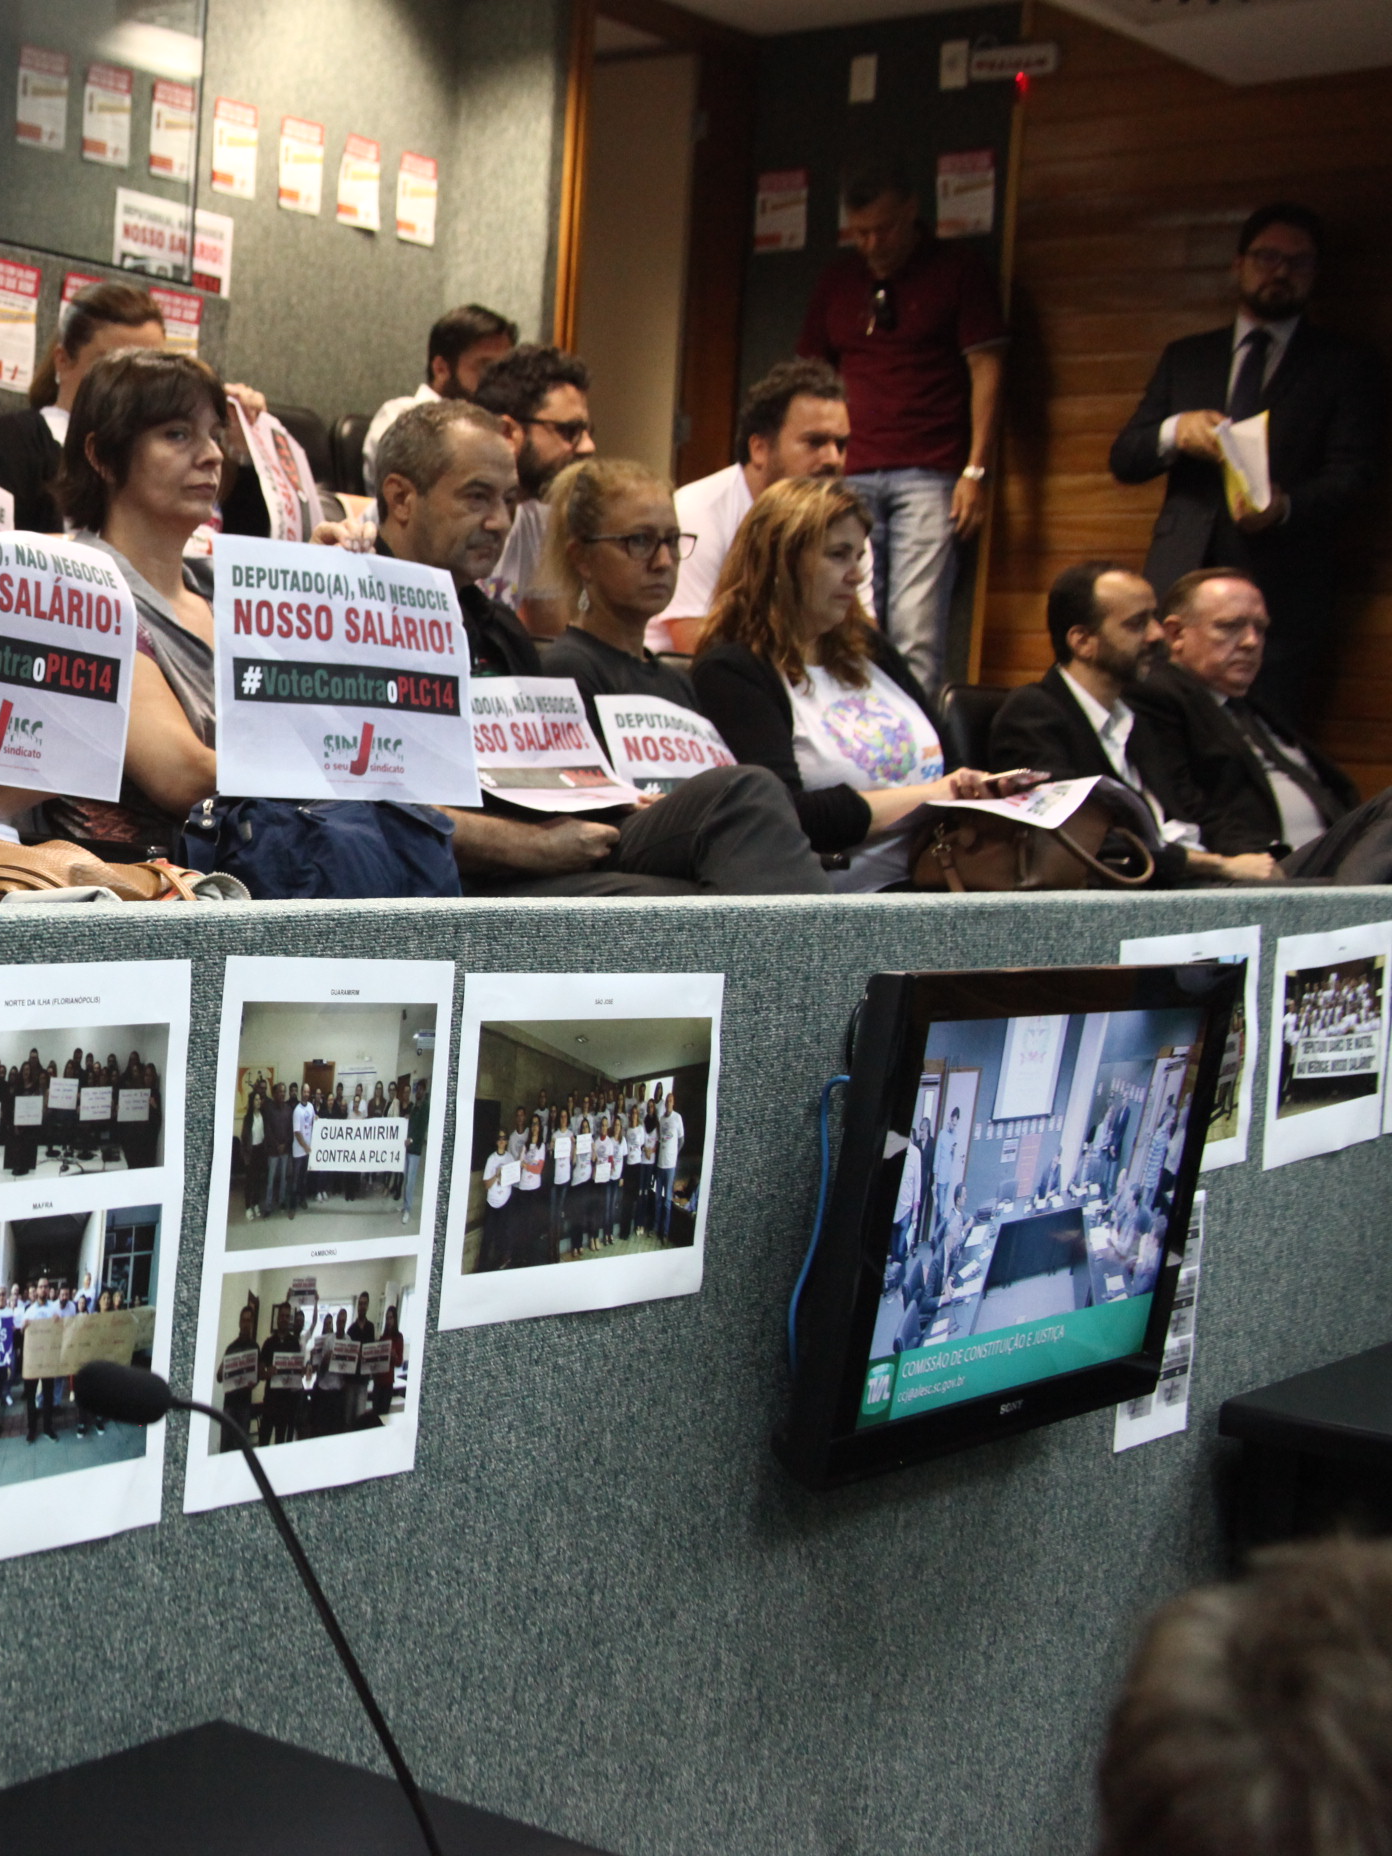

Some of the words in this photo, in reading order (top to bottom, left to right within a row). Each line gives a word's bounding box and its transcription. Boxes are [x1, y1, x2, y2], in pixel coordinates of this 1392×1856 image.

[15, 540, 48, 572] NÃO
[51, 554, 118, 590] NEGOCIE
[232, 565, 355, 601] DEPUTADO(A),
[358, 575, 386, 601] NÃO
[389, 584, 450, 612] NEGOCIE
[233, 598, 333, 642] NOSSO
[345, 606, 455, 655] SALÁRIO!
[241, 665, 455, 710] #VoteContraoPLC14
[473, 722, 508, 753] SSO
[510, 714, 590, 751] SALÁRIO!
[3, 744, 42, 760] sindicato
[623, 736, 705, 764] NOSSO
[369, 762, 405, 774] sindicato
[4, 999, 25, 1007] NORTE
[37, 998, 50, 1006] ILHA
[320, 1125, 400, 1140] GUARAMIRIM
[315, 1149, 357, 1163] CONTRA
[359, 1150, 367, 1163] A
[368, 1150, 389, 1163] PLC
[390, 1150, 401, 1163] 14
[32, 1201, 54, 1210] MAFRA
[901, 1351, 950, 1379] COMISSÃO
[950, 1348, 963, 1367] DE
[963, 1331, 1027, 1363] CONSTITUIÇÃO
[1032, 1324, 1066, 1346] JUSTIÇA
[999, 1399, 1024, 1415] SONY
